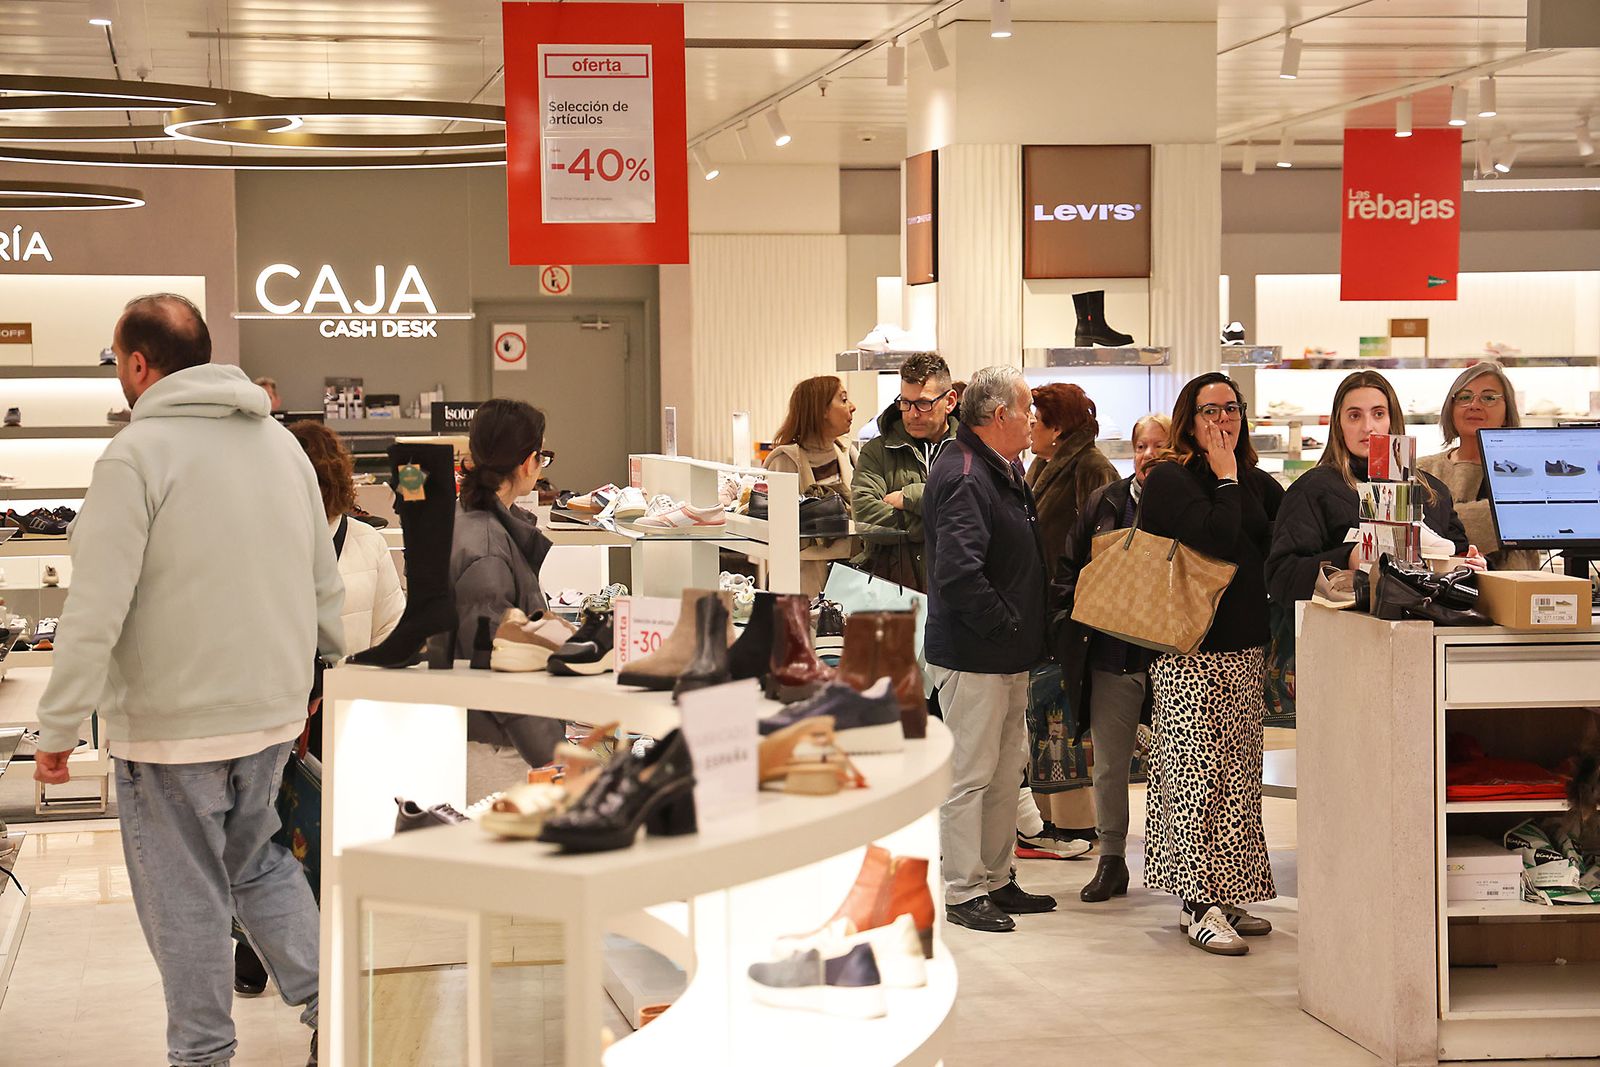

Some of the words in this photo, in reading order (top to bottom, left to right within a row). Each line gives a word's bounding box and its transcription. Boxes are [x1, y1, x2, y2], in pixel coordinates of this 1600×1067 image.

[572, 58, 621, 72] oferta
[549, 101, 609, 112] Selección
[612, 101, 629, 112] de
[549, 114, 603, 125] artículos
[551, 148, 650, 181] -40%
[1348, 188, 1370, 199] Las
[1348, 193, 1455, 225] rebajas
[255, 263, 438, 315] CAJA
[0, 329, 25, 337] OFF
[319, 319, 377, 338] CASH
[381, 319, 438, 338] DESK
[619, 616, 627, 662] oferta
